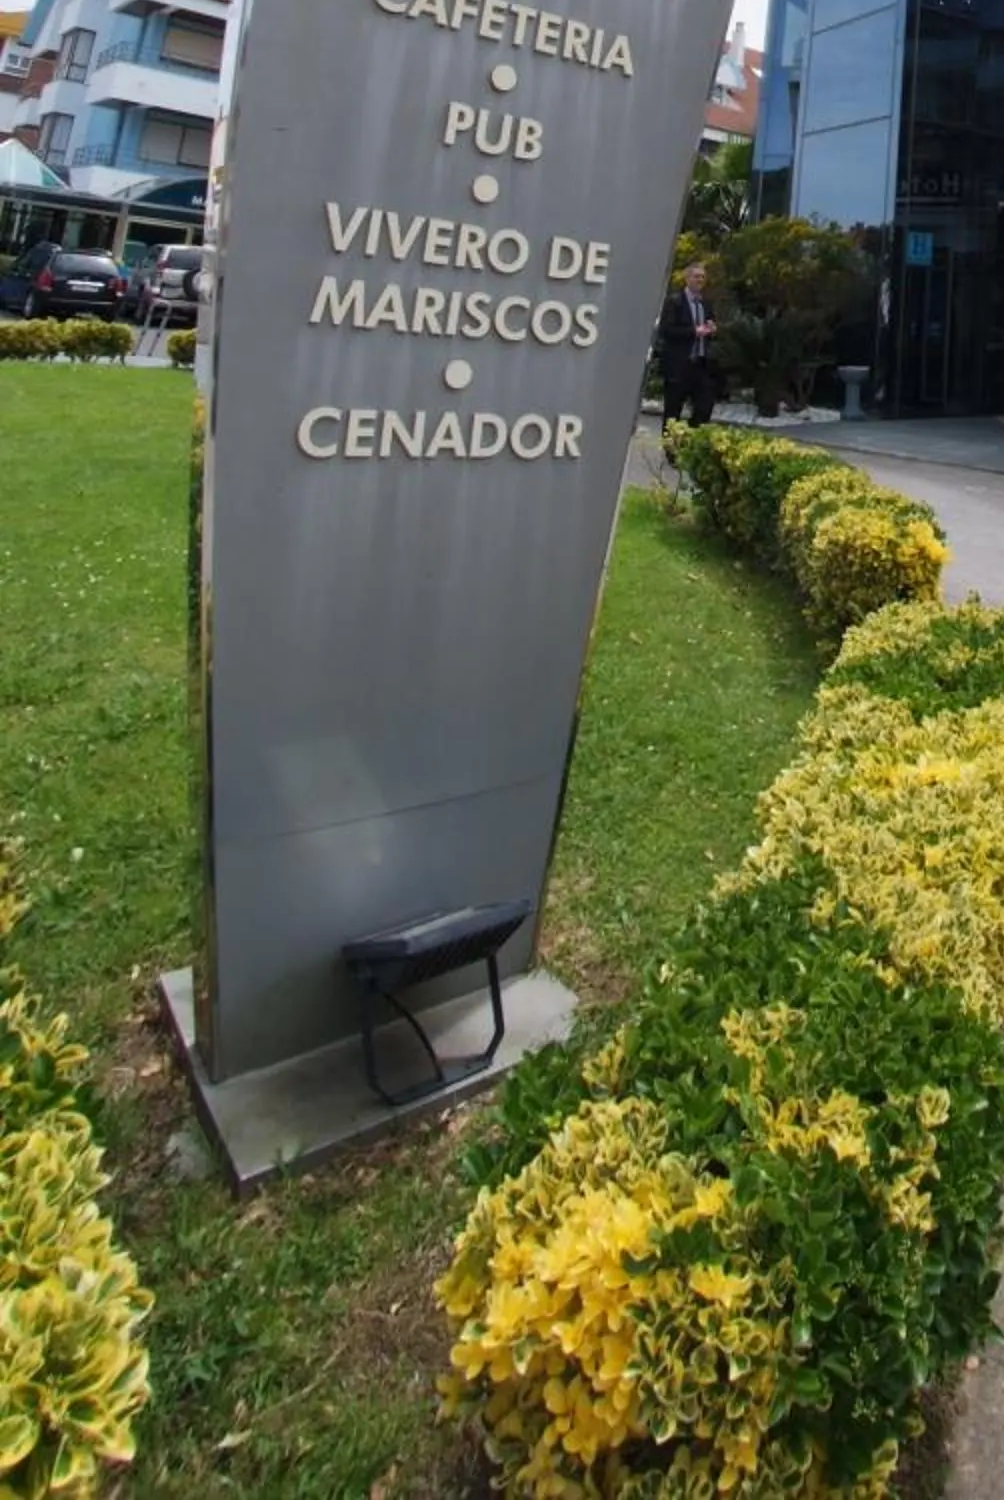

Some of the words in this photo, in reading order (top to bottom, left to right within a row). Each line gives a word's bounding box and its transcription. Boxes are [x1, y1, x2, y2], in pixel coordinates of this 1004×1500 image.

[443, 101, 543, 161] PUB
[325, 202, 529, 275] VIVERO
[548, 236, 610, 284] DE
[309, 275, 599, 347] MARISCOS
[297, 406, 582, 460] CENADOR
